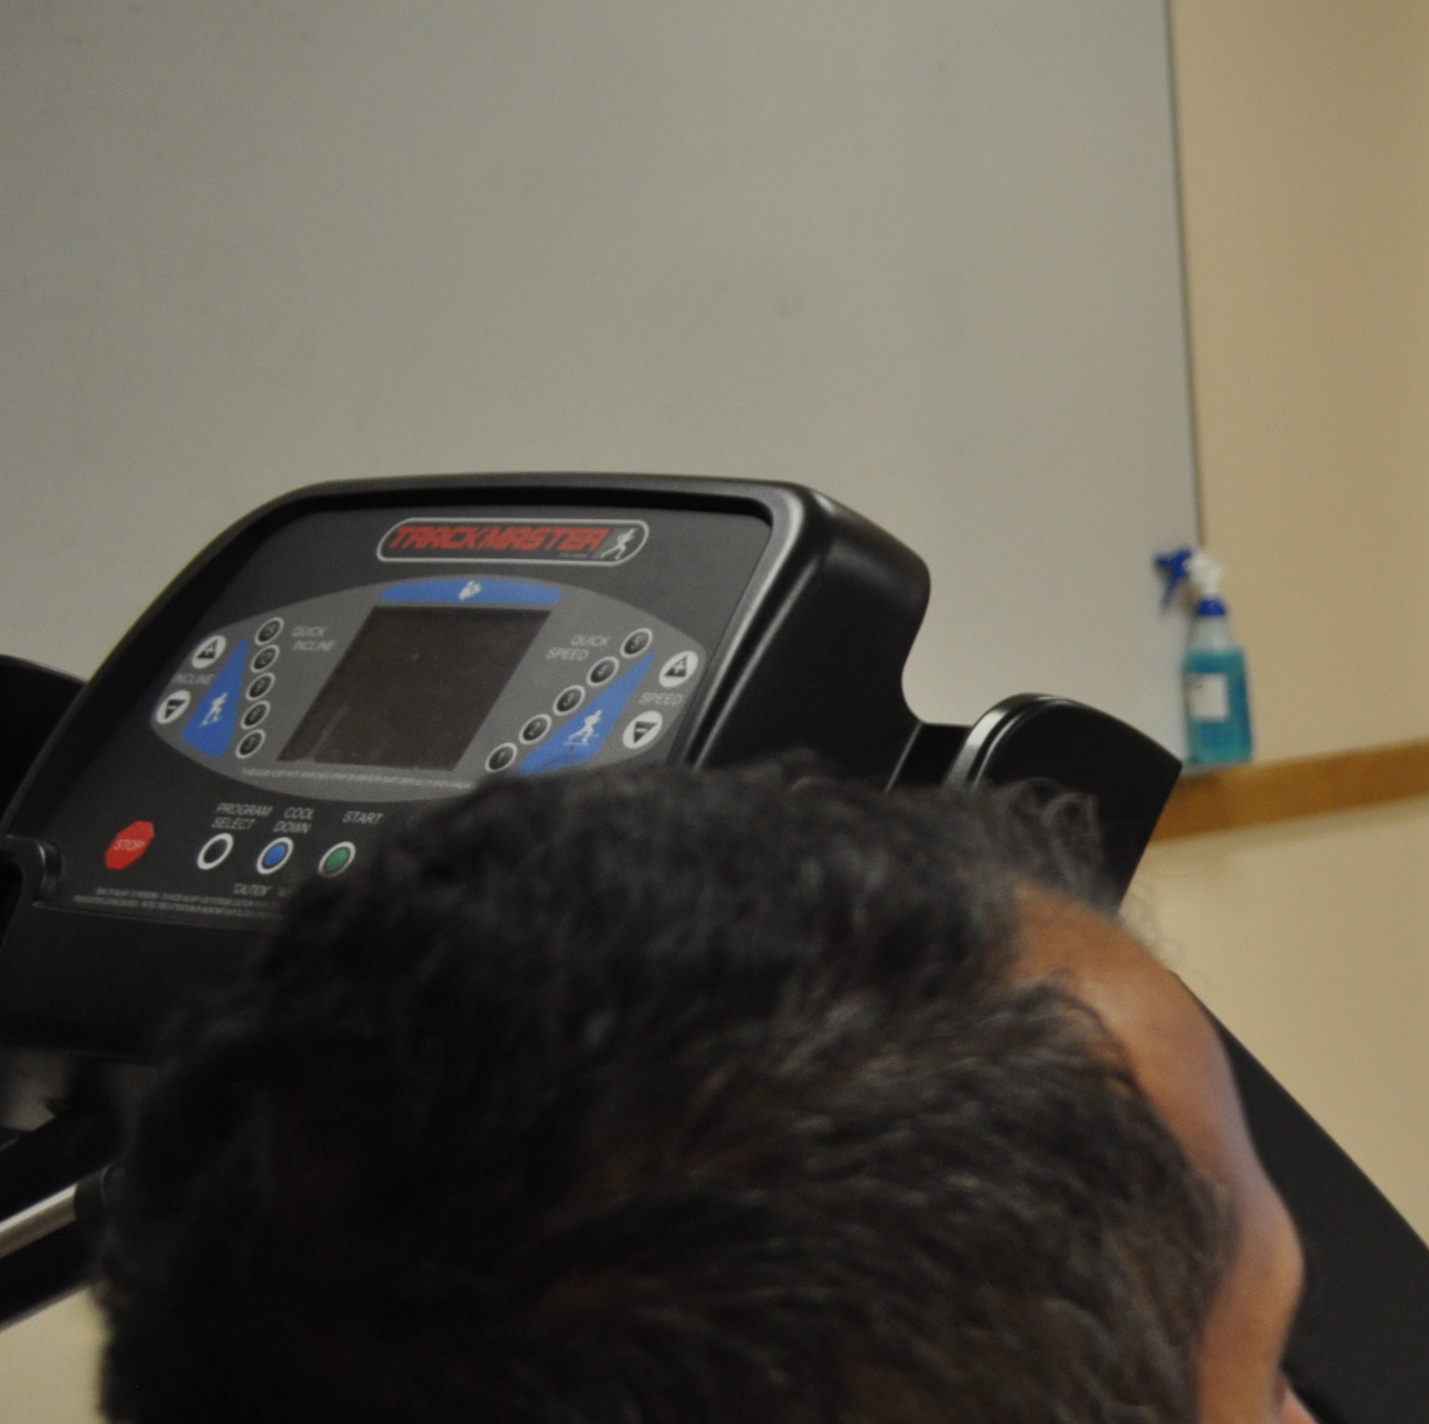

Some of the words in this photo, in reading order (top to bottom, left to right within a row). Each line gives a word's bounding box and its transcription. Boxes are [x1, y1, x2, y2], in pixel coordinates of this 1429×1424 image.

[390, 526, 611, 551] TRACKMASTER
[216, 803, 273, 817] PROGRAM
[285, 807, 315, 820] COOL
[343, 811, 383, 824] START
[212, 818, 256, 830] SELECT
[273, 821, 313, 834] DOWN
